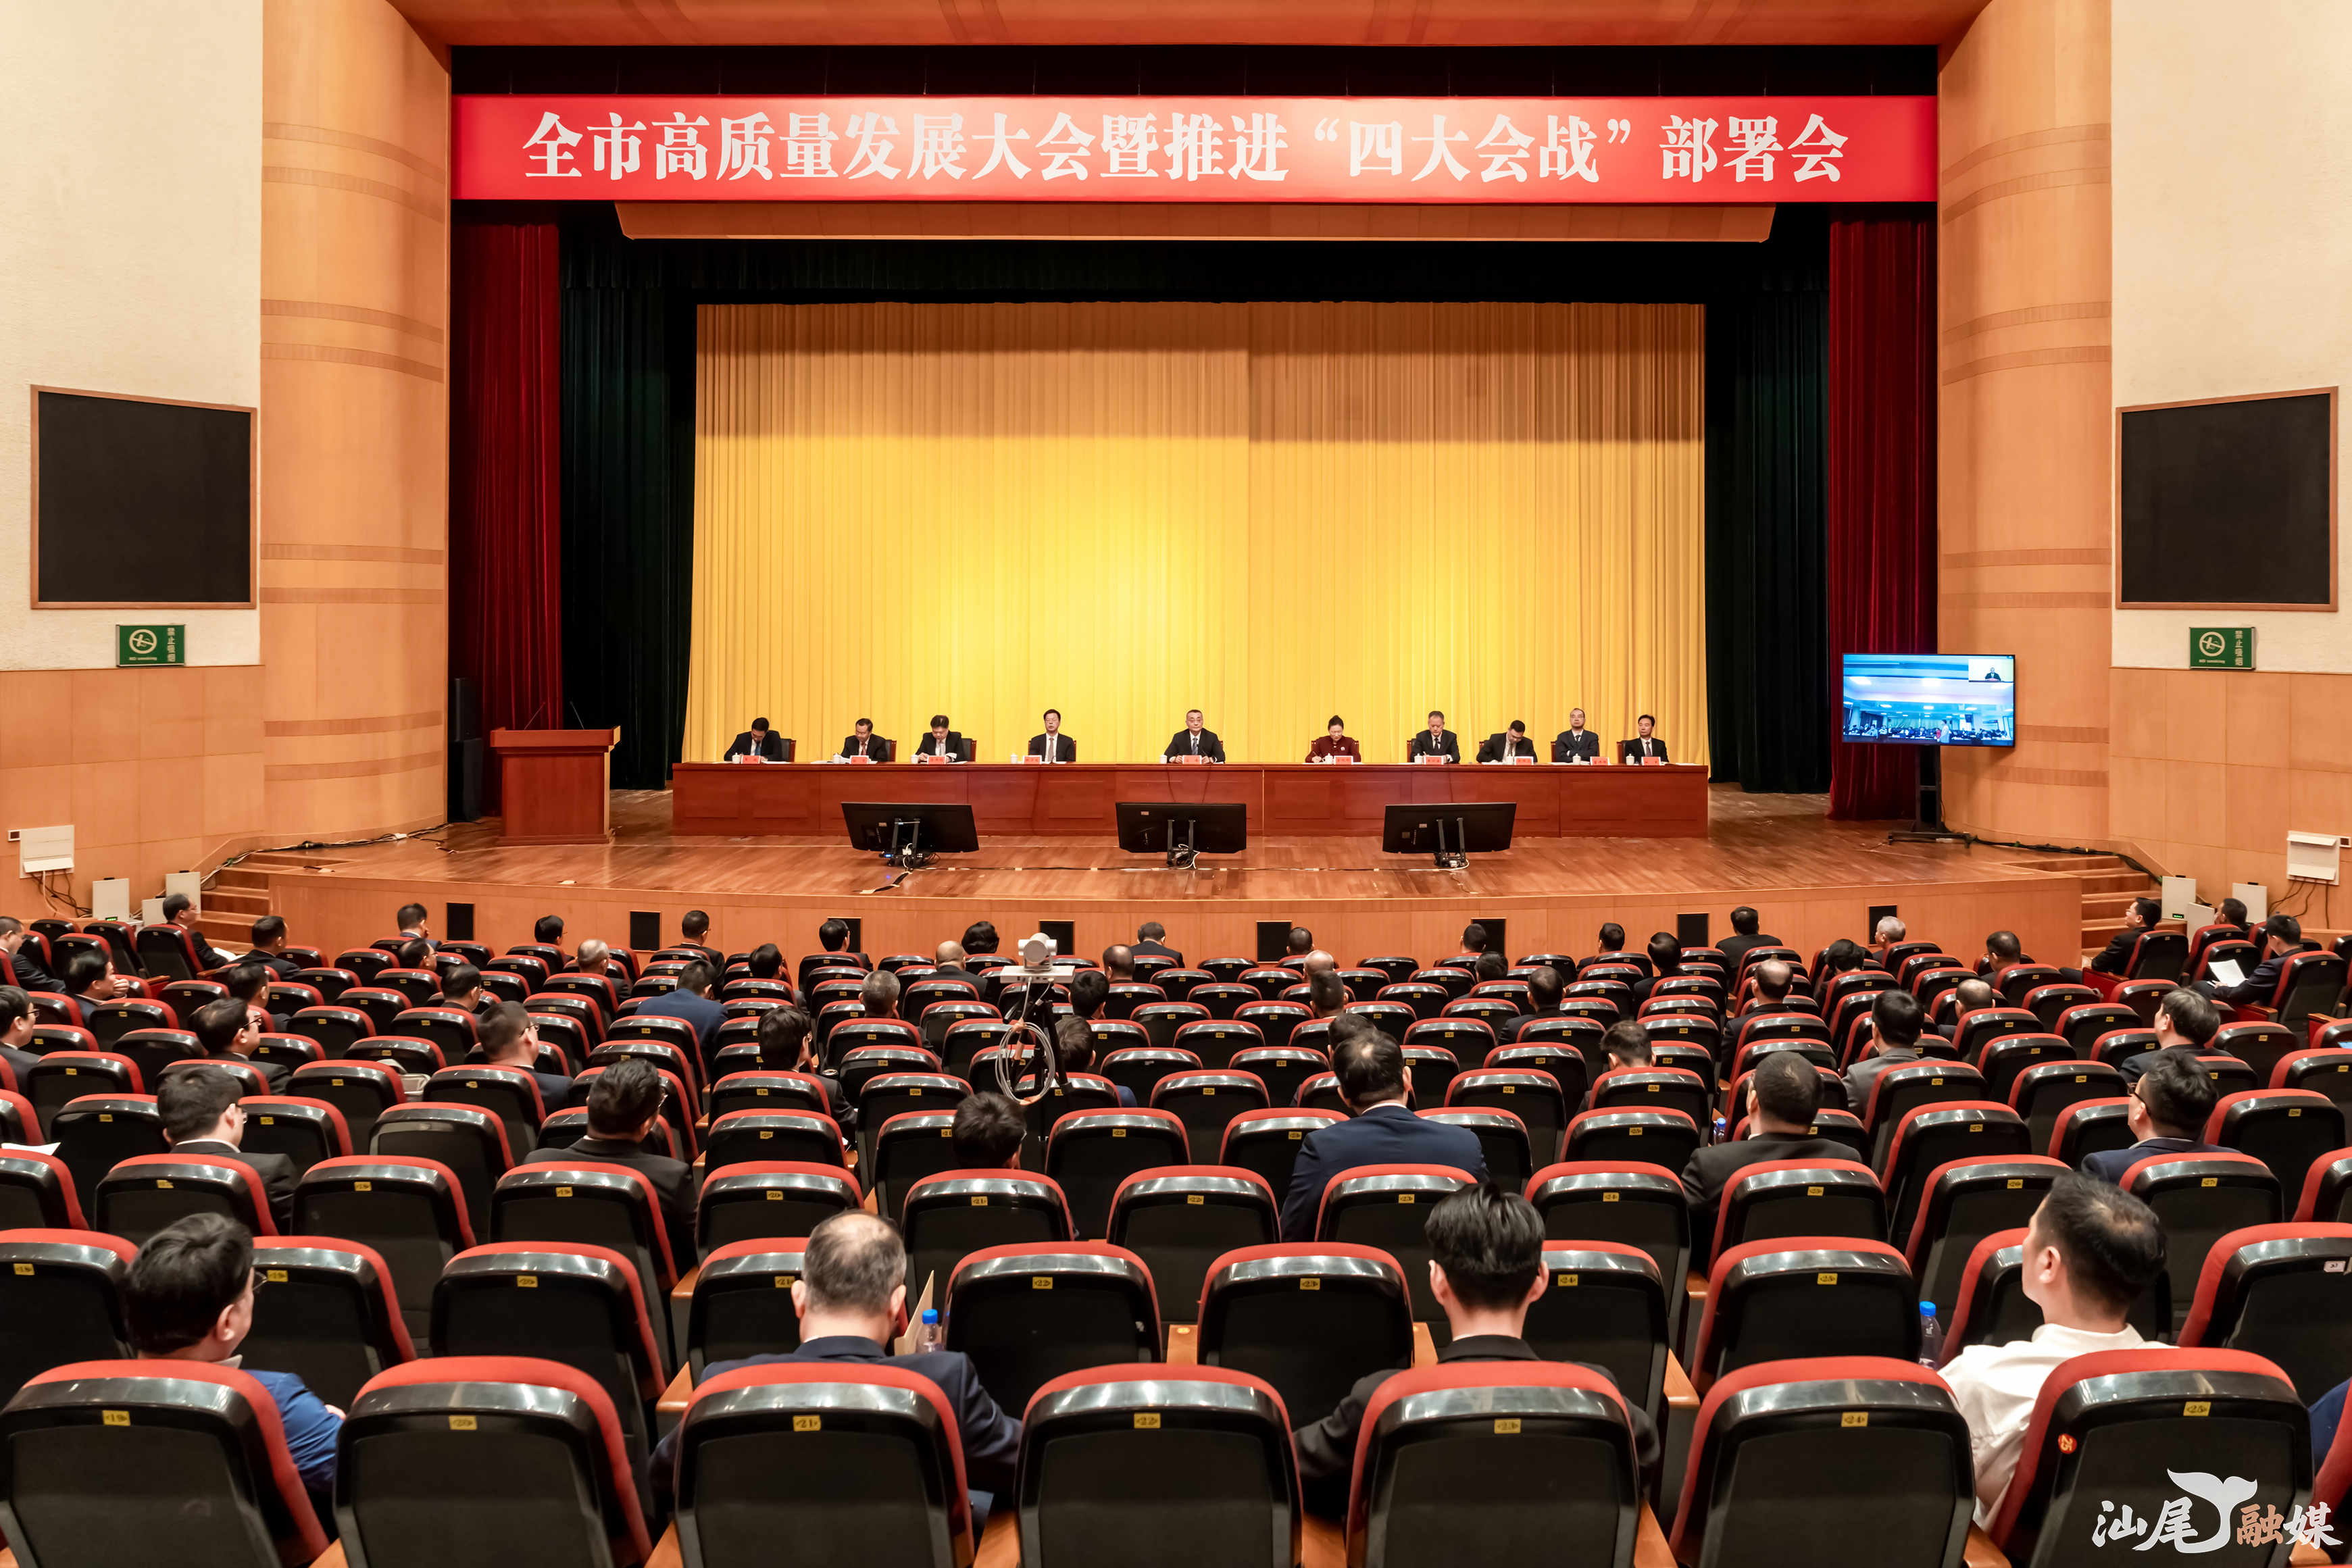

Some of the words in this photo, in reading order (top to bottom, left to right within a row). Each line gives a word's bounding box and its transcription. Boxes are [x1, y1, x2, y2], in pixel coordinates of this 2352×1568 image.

[523, 111, 1848, 183] 全市高质量发展大会暨推进“四大会战”部署会
[167, 628, 176, 663] 禁止吸烟
[2234, 630, 2243, 665] 禁止吸烟
[2188, 1404, 2205, 1413] 25
[799, 1419, 816, 1428] 21
[1139, 1416, 1155, 1425] 22
[1847, 1415, 1863, 1424] 24
[2061, 1435, 2072, 1452] 25
